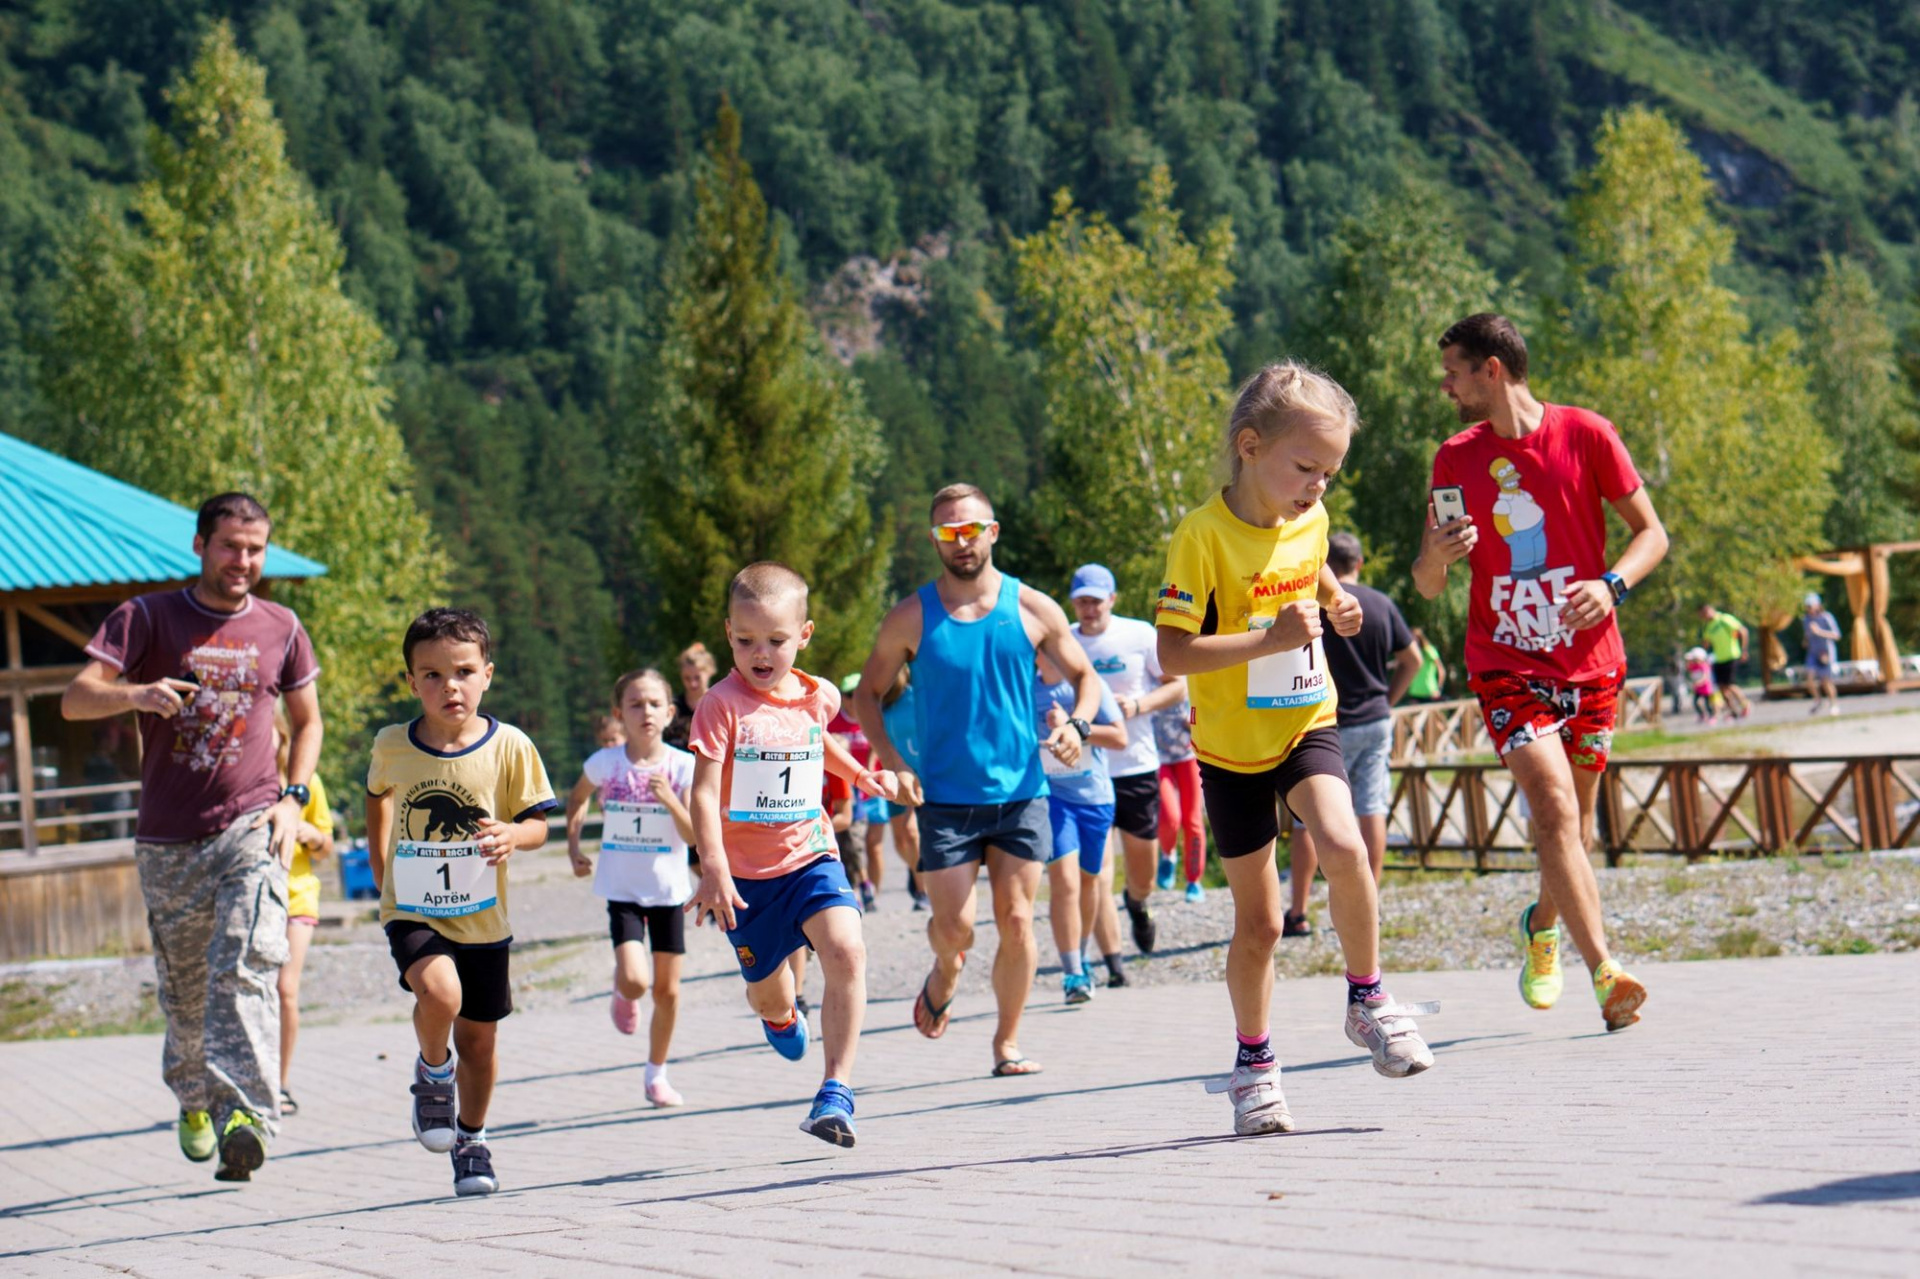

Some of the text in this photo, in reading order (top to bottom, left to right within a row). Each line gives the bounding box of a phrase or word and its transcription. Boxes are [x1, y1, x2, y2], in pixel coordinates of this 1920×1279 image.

[1490, 565, 1575, 612] FAT
[1302, 641, 1315, 671] 1
[1291, 673, 1323, 691] Лиза
[778, 766, 791, 795] 1
[756, 795, 806, 809] Максим
[632, 815, 642, 835] 1
[436, 862, 451, 891] 1
[423, 891, 471, 907] Артём
[462, 903, 480, 915] KIDS
